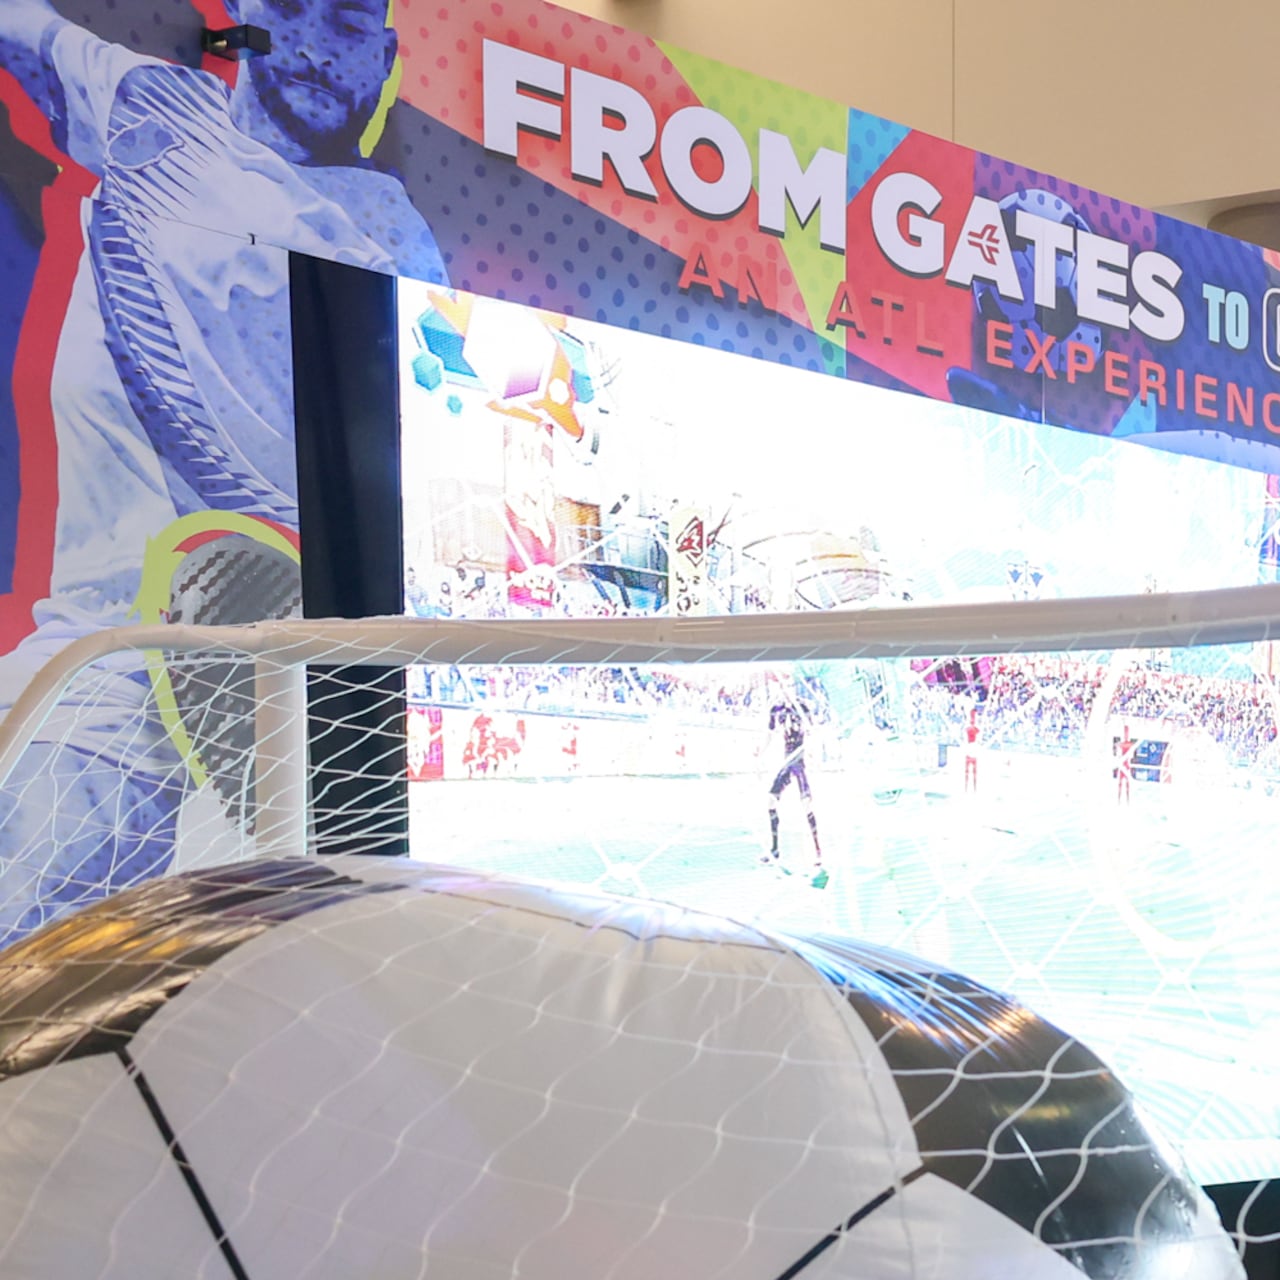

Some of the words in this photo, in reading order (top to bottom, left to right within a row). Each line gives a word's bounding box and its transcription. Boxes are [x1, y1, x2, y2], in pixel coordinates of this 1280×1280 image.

[482, 38, 847, 256] FROM
[871, 172, 1186, 342] GATES
[1202, 284, 1249, 350] TO
[677, 241, 779, 316] AN
[825, 281, 946, 357] ATL
